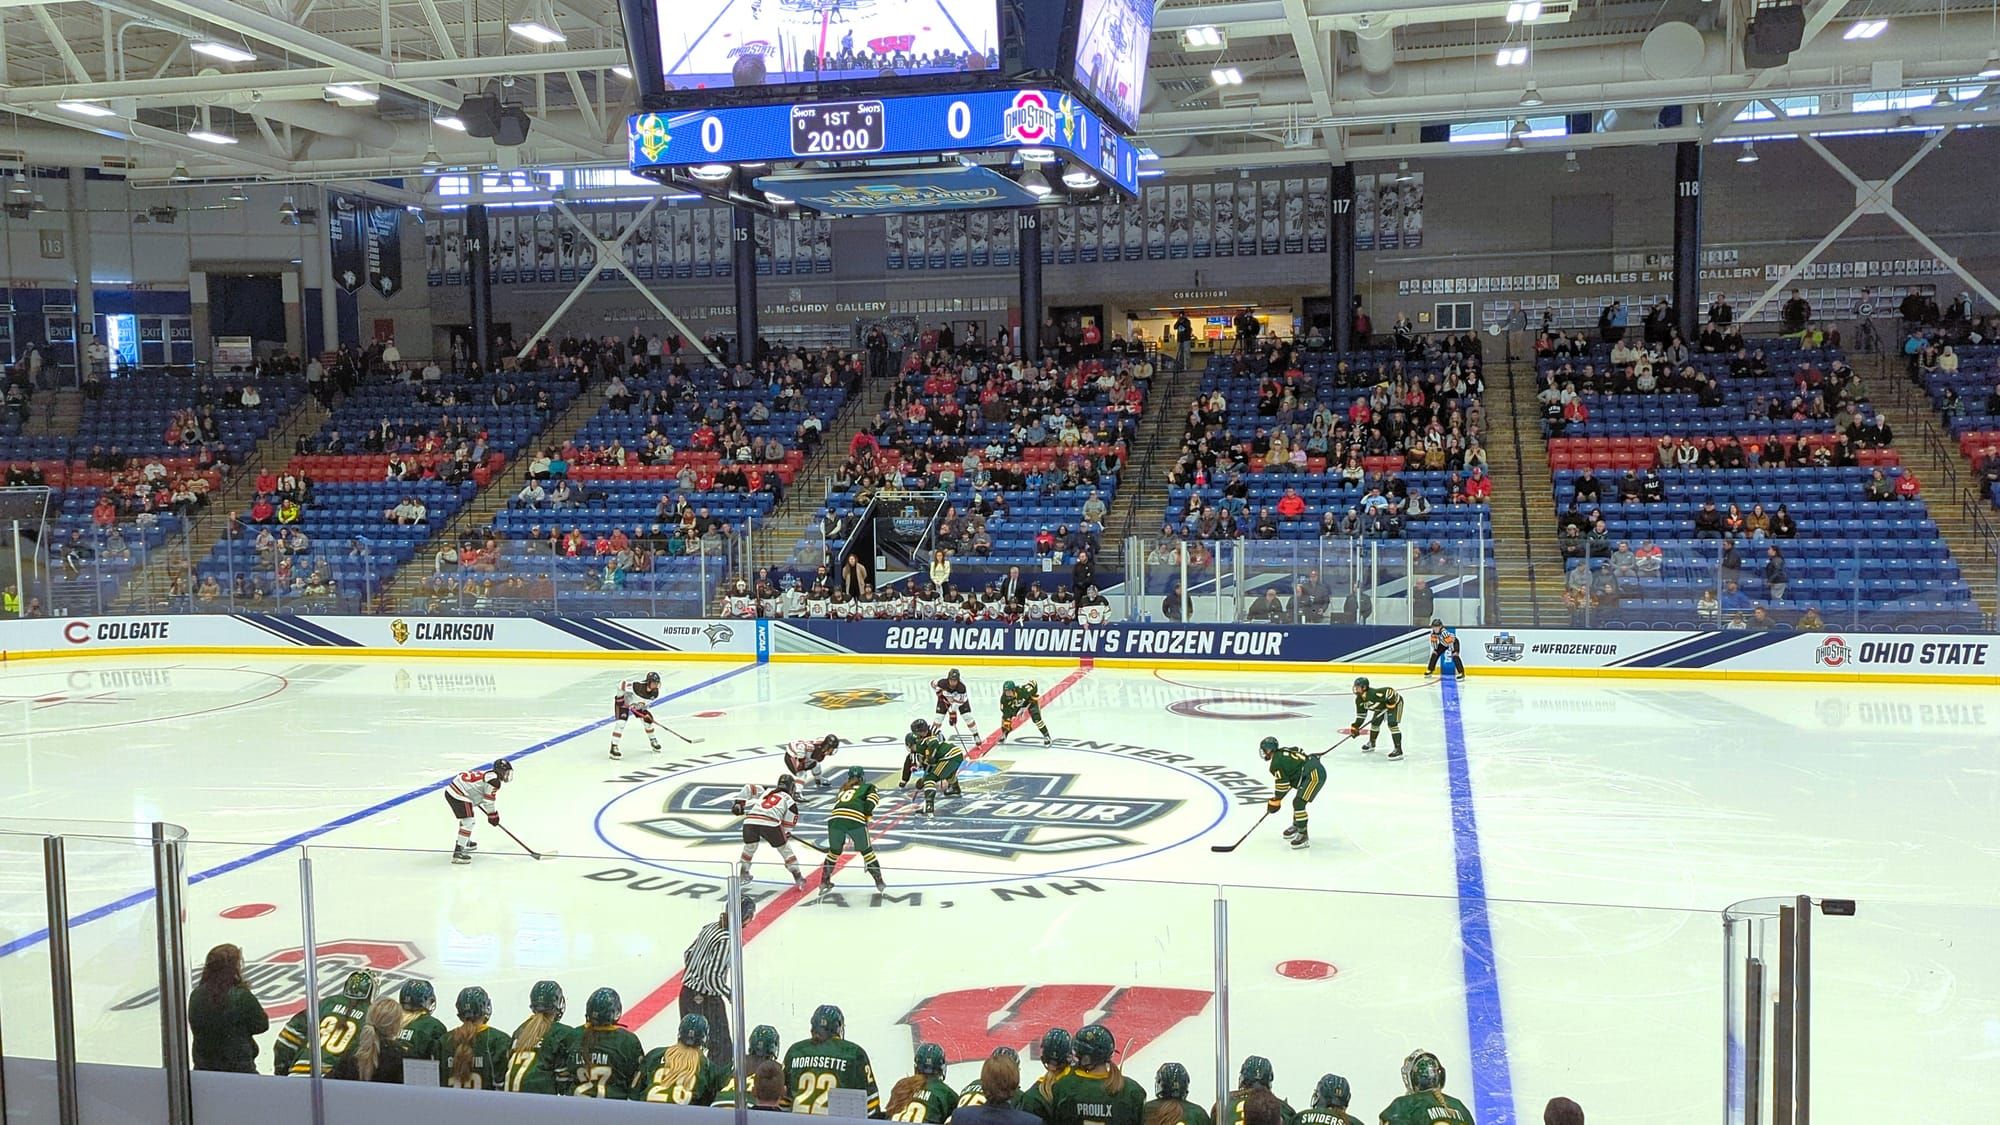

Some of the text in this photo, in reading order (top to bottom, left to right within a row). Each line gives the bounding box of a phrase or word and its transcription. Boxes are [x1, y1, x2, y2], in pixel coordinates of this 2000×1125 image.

[798, 119, 805, 129] 0
[823, 112, 850, 126] 1ST
[865, 115, 872, 126] 0
[948, 101, 970, 139] 0
[702, 117, 723, 152] 0
[1081, 114, 1087, 150] 0
[808, 129, 869, 151] 20:00
[1126, 151, 1131, 183] 0
[1680, 181, 1698, 197] 118
[1333, 199, 1350, 214] 117
[1020, 215, 1036, 229] 116
[43, 240, 61, 253] 113
[467, 239, 481, 252] 114
[1576, 273, 1637, 285] CHARLES
[1642, 272, 1654, 281] E.
[1699, 268, 1760, 279] GALLERY
[1174, 291, 1228, 299] CONCESSIONS
[776, 304, 829, 314] McCURDY
[836, 302, 887, 312] GALLERY
[50, 327, 72, 337] EXIT
[142, 328, 161, 338] EXIT
[171, 328, 191, 338] EXIT
[97, 622, 169, 640] COLGATE
[415, 622, 494, 641] CLARKSON
[663, 627, 690, 635] HOSTED
[758, 626, 766, 651] NCAA
[885, 627, 1282, 655] 2024 NCAA WOMEN'S FROZEN FOUR
[1532, 643, 1617, 655] #WFROZENFOUR
[1859, 642, 1988, 665] OHIO STATE
[954, 799, 1131, 821] FOUR
[991, 879, 1106, 902] NH
[505, 1051, 536, 1091] 17
[792, 1056, 847, 1071] MORISSETTE
[793, 1072, 838, 1114] 22
[1077, 1103, 1112, 1117] PROULX
